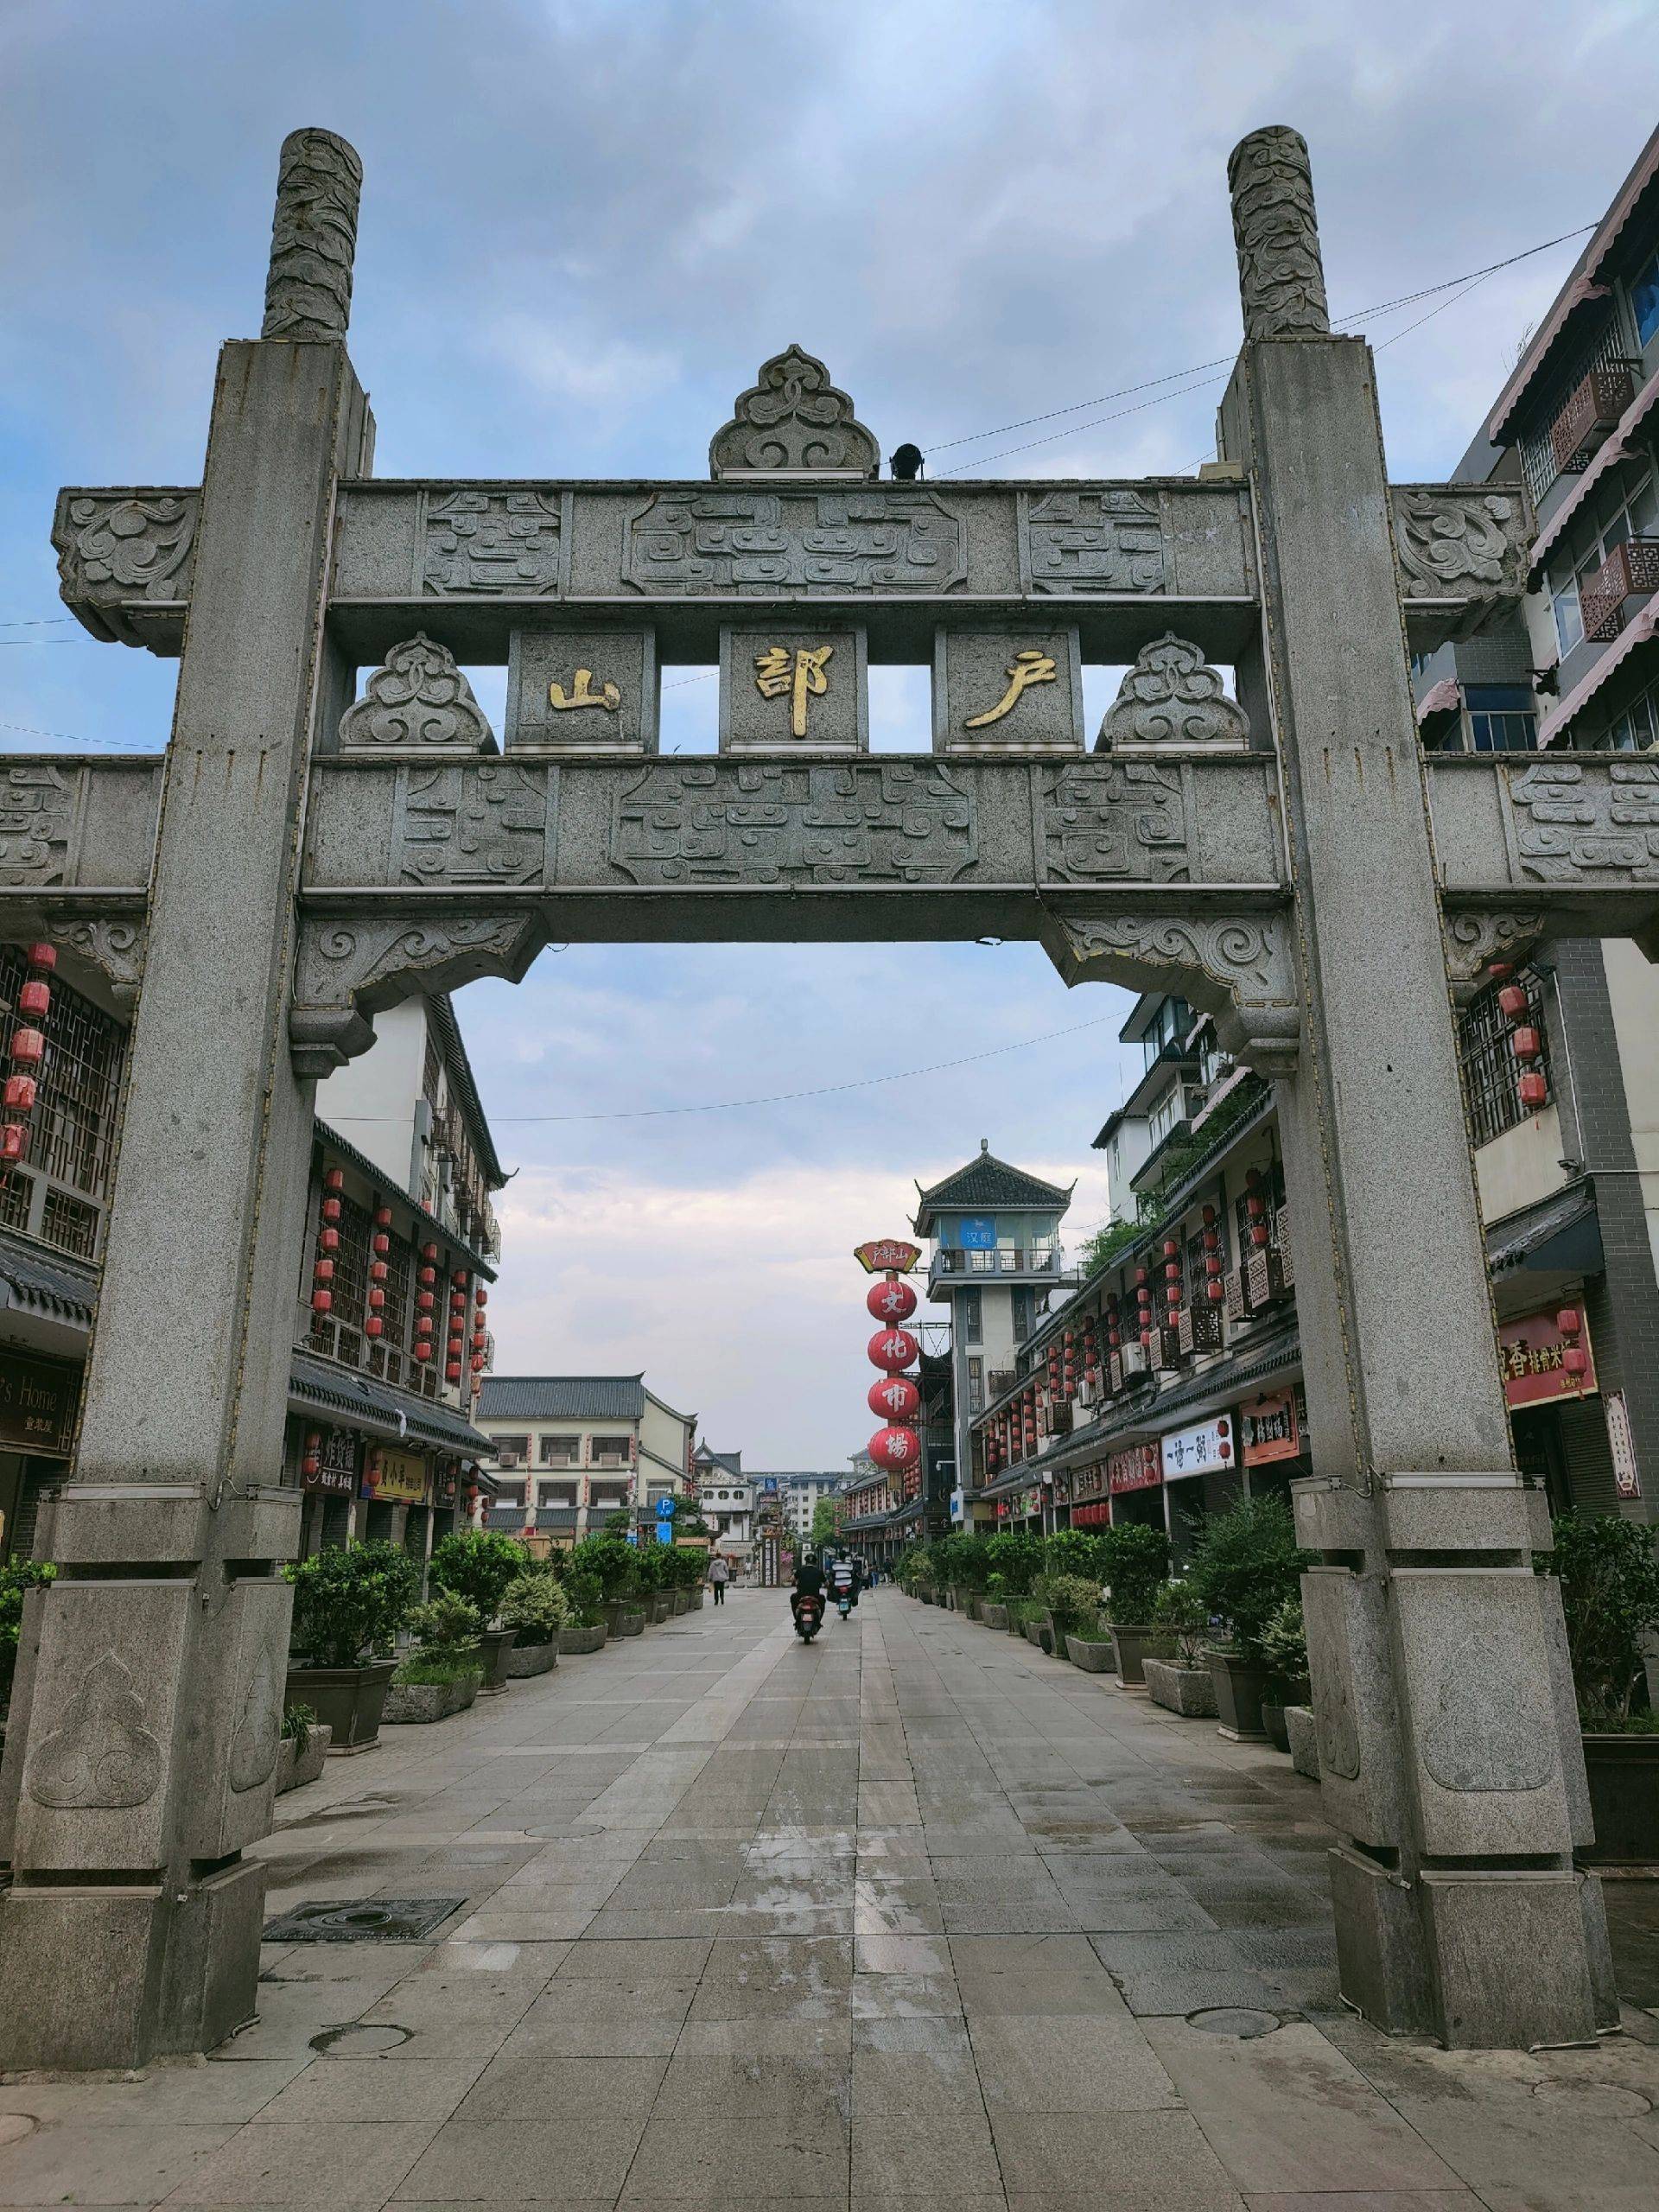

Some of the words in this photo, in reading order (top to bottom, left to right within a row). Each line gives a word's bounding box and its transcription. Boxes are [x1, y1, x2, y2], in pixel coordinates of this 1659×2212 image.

[966, 1231, 993, 1243] 汉庭
[873, 1246, 907, 1264] 户部山
[19, 1376, 57, 1411] Home
[662, 1499, 671, 1510] P
